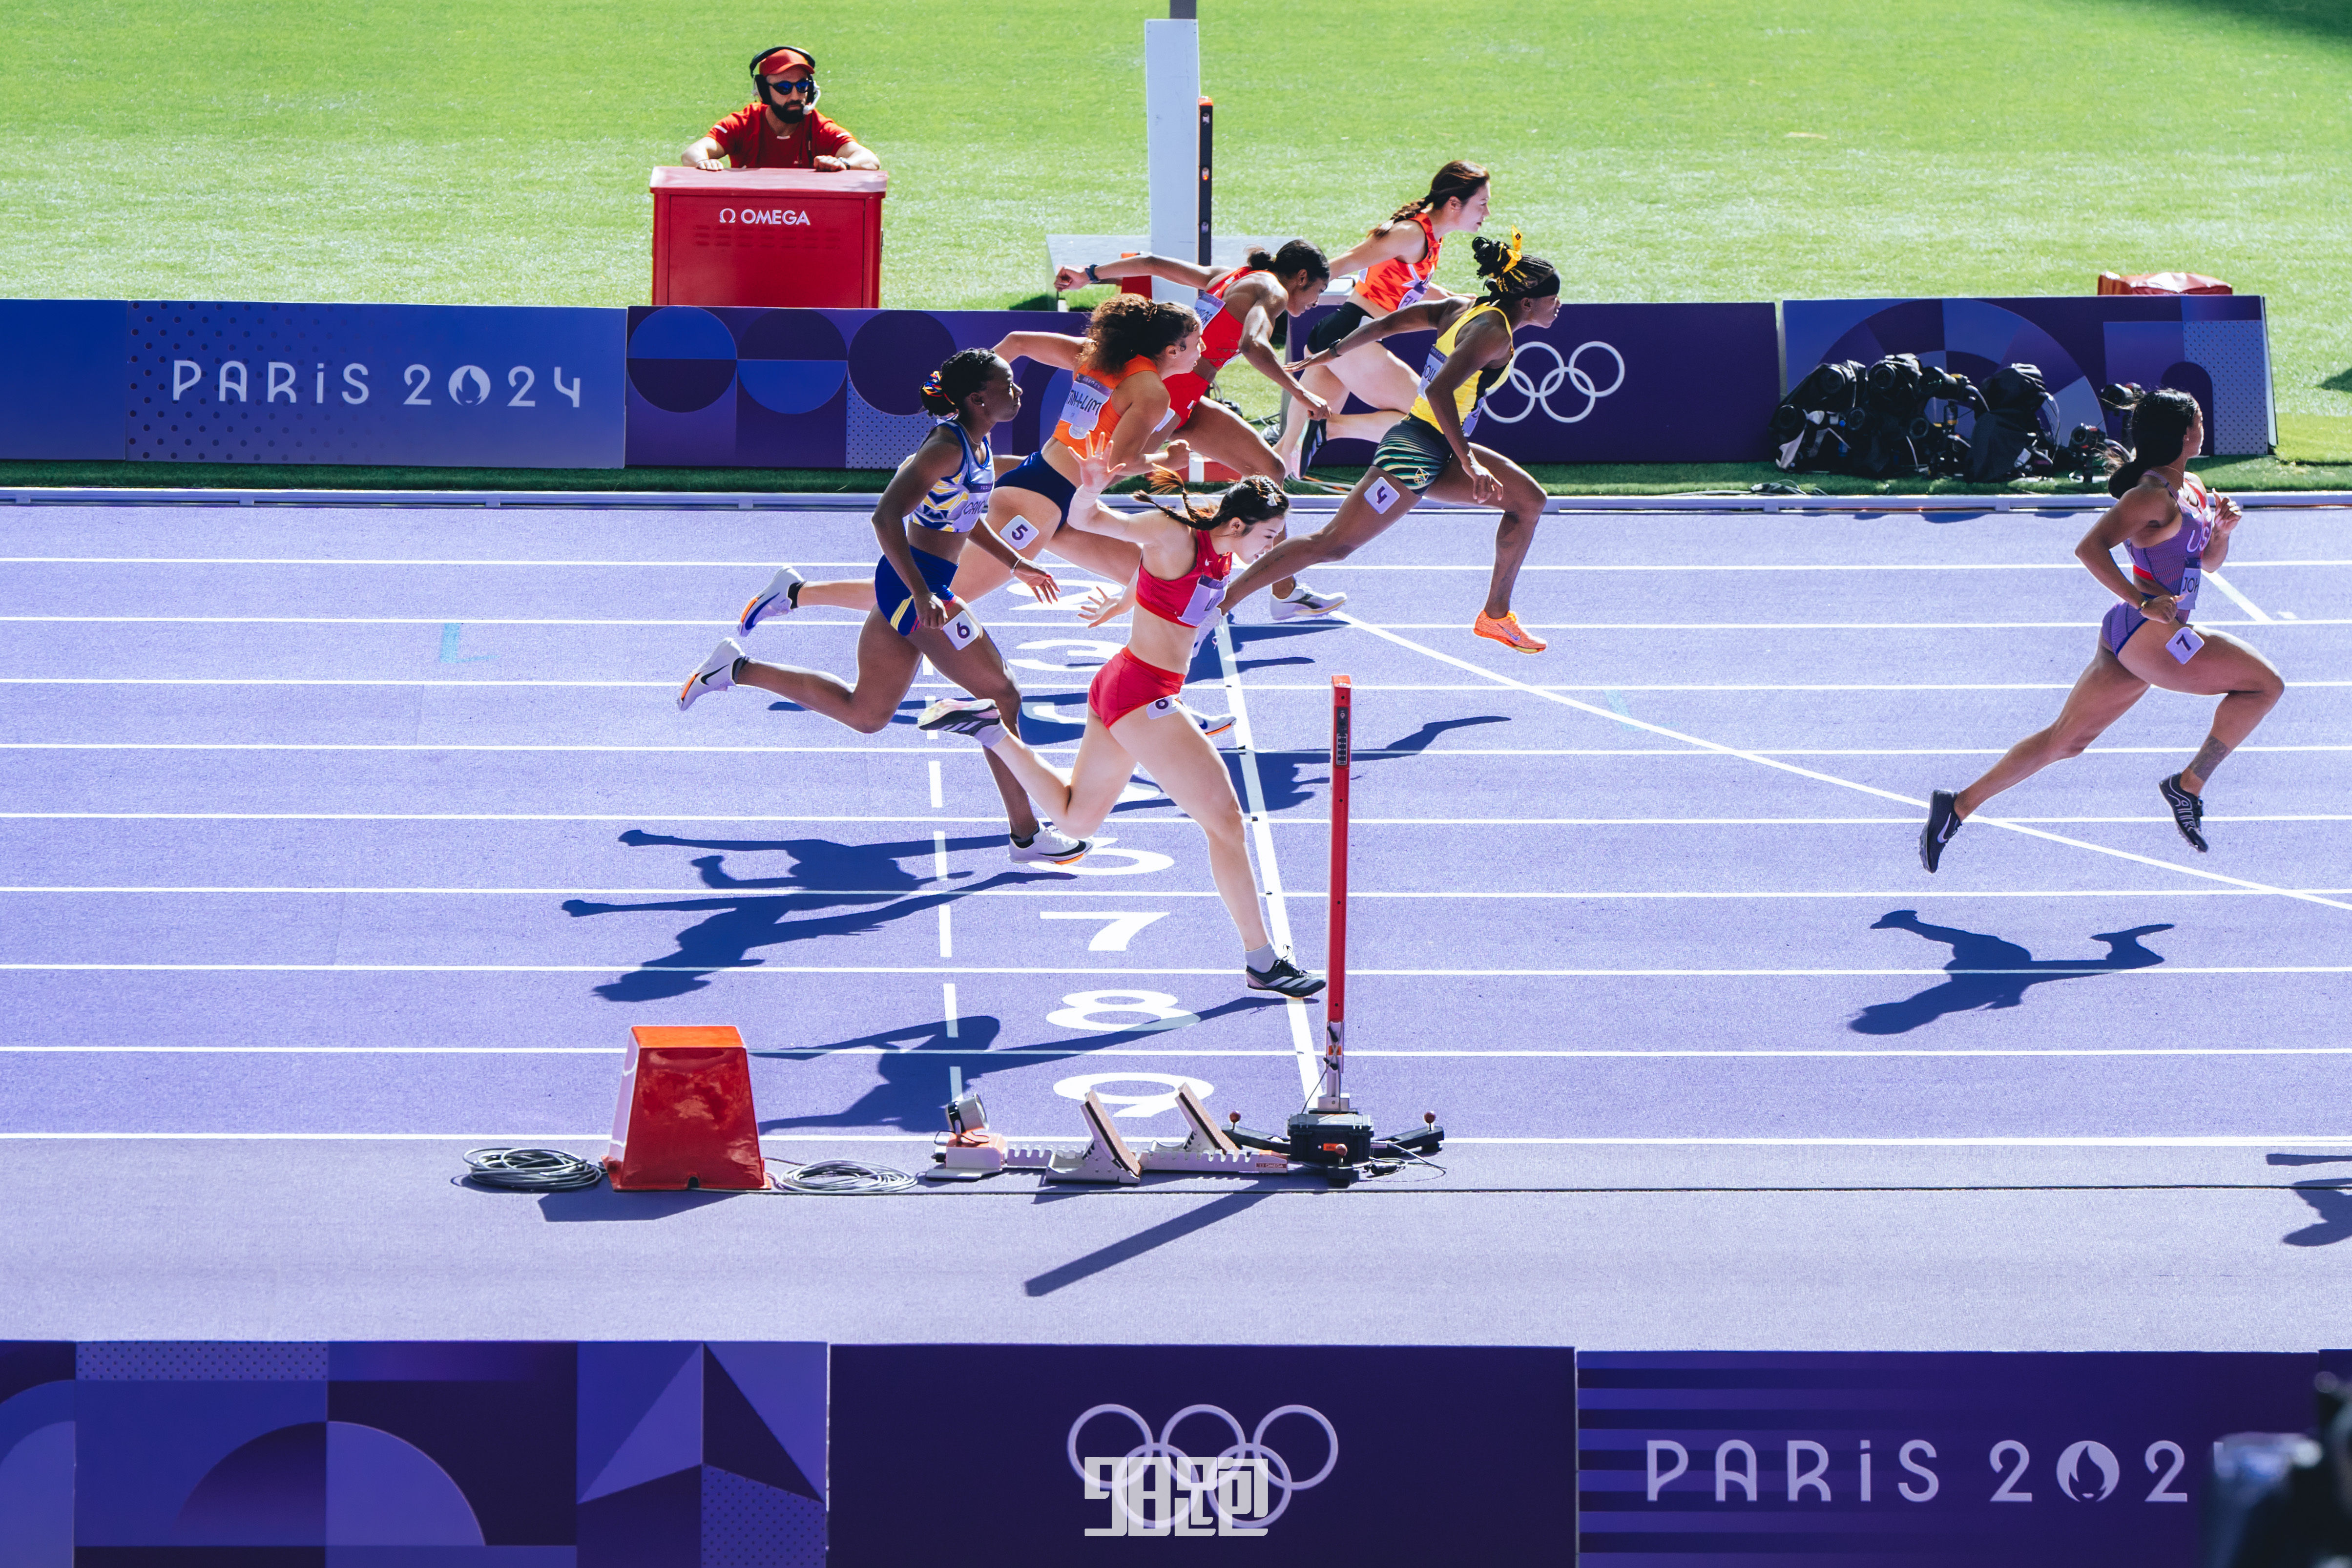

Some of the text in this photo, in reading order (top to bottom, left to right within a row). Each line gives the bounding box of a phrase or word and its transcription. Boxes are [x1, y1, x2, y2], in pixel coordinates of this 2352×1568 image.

[741, 209, 811, 225] OMEGA
[1011, 524, 1028, 541] 5
[956, 622, 971, 639] 6
[2176, 634, 2192, 651] 7
[1040, 912, 1170, 951] 7
[1046, 990, 1201, 1032] 8
[1053, 1072, 1214, 1117] 9
[1989, 1440, 2223, 1503] 202
